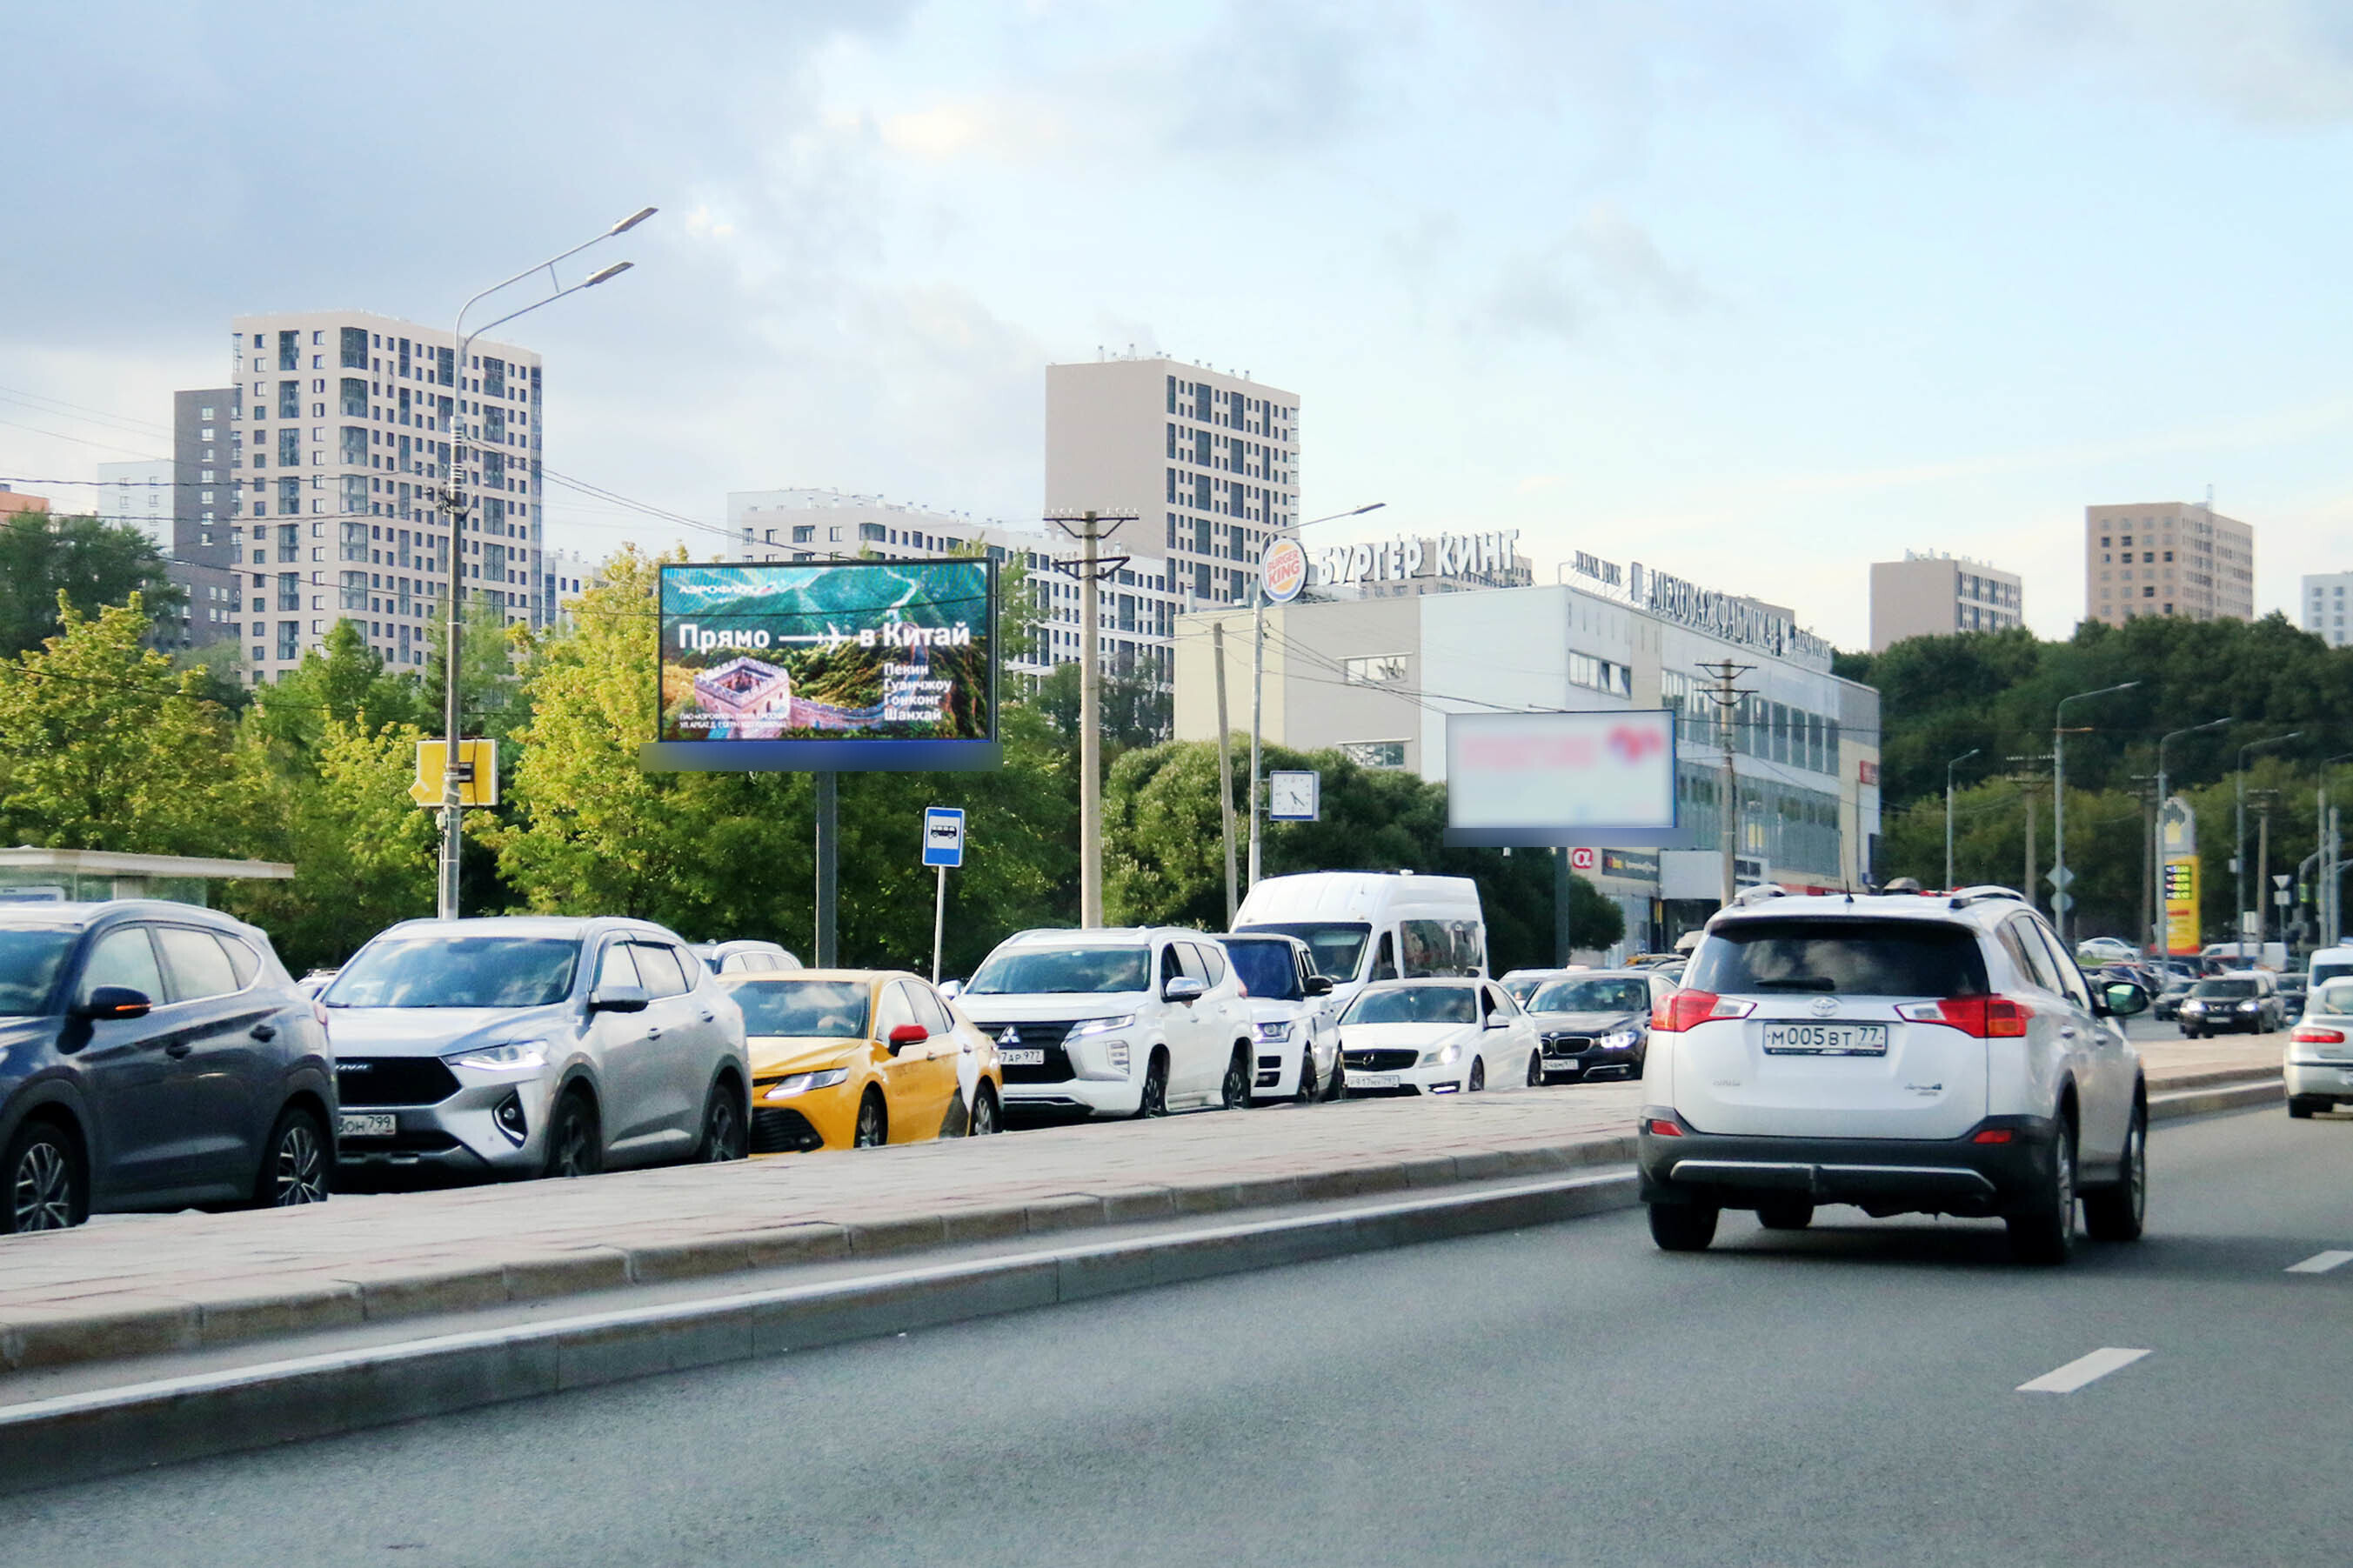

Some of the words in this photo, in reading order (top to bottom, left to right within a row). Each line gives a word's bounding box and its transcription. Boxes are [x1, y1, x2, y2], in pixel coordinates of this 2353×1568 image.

[1267, 549, 1300, 573] BURGER
[1317, 540, 1423, 585] БУРГЕР
[1435, 529, 1519, 576] КИНГ
[1267, 560, 1300, 588] KING
[1651, 569, 1715, 628] МЕХОВАЯ
[1718, 595, 1778, 654] ФАБРИКА
[678, 624, 770, 653] Прямо
[859, 629, 874, 647] в
[883, 621, 970, 647] Китай
[884, 662, 929, 676] Пекин
[884, 677, 953, 693] Гуанчжоу
[884, 693, 942, 705] Гонконг
[884, 707, 942, 721] Шанхай
[1771, 1027, 1852, 1046] М005ВТ
[1858, 1027, 1878, 1042] 77
[367, 1116, 391, 1129] 799
